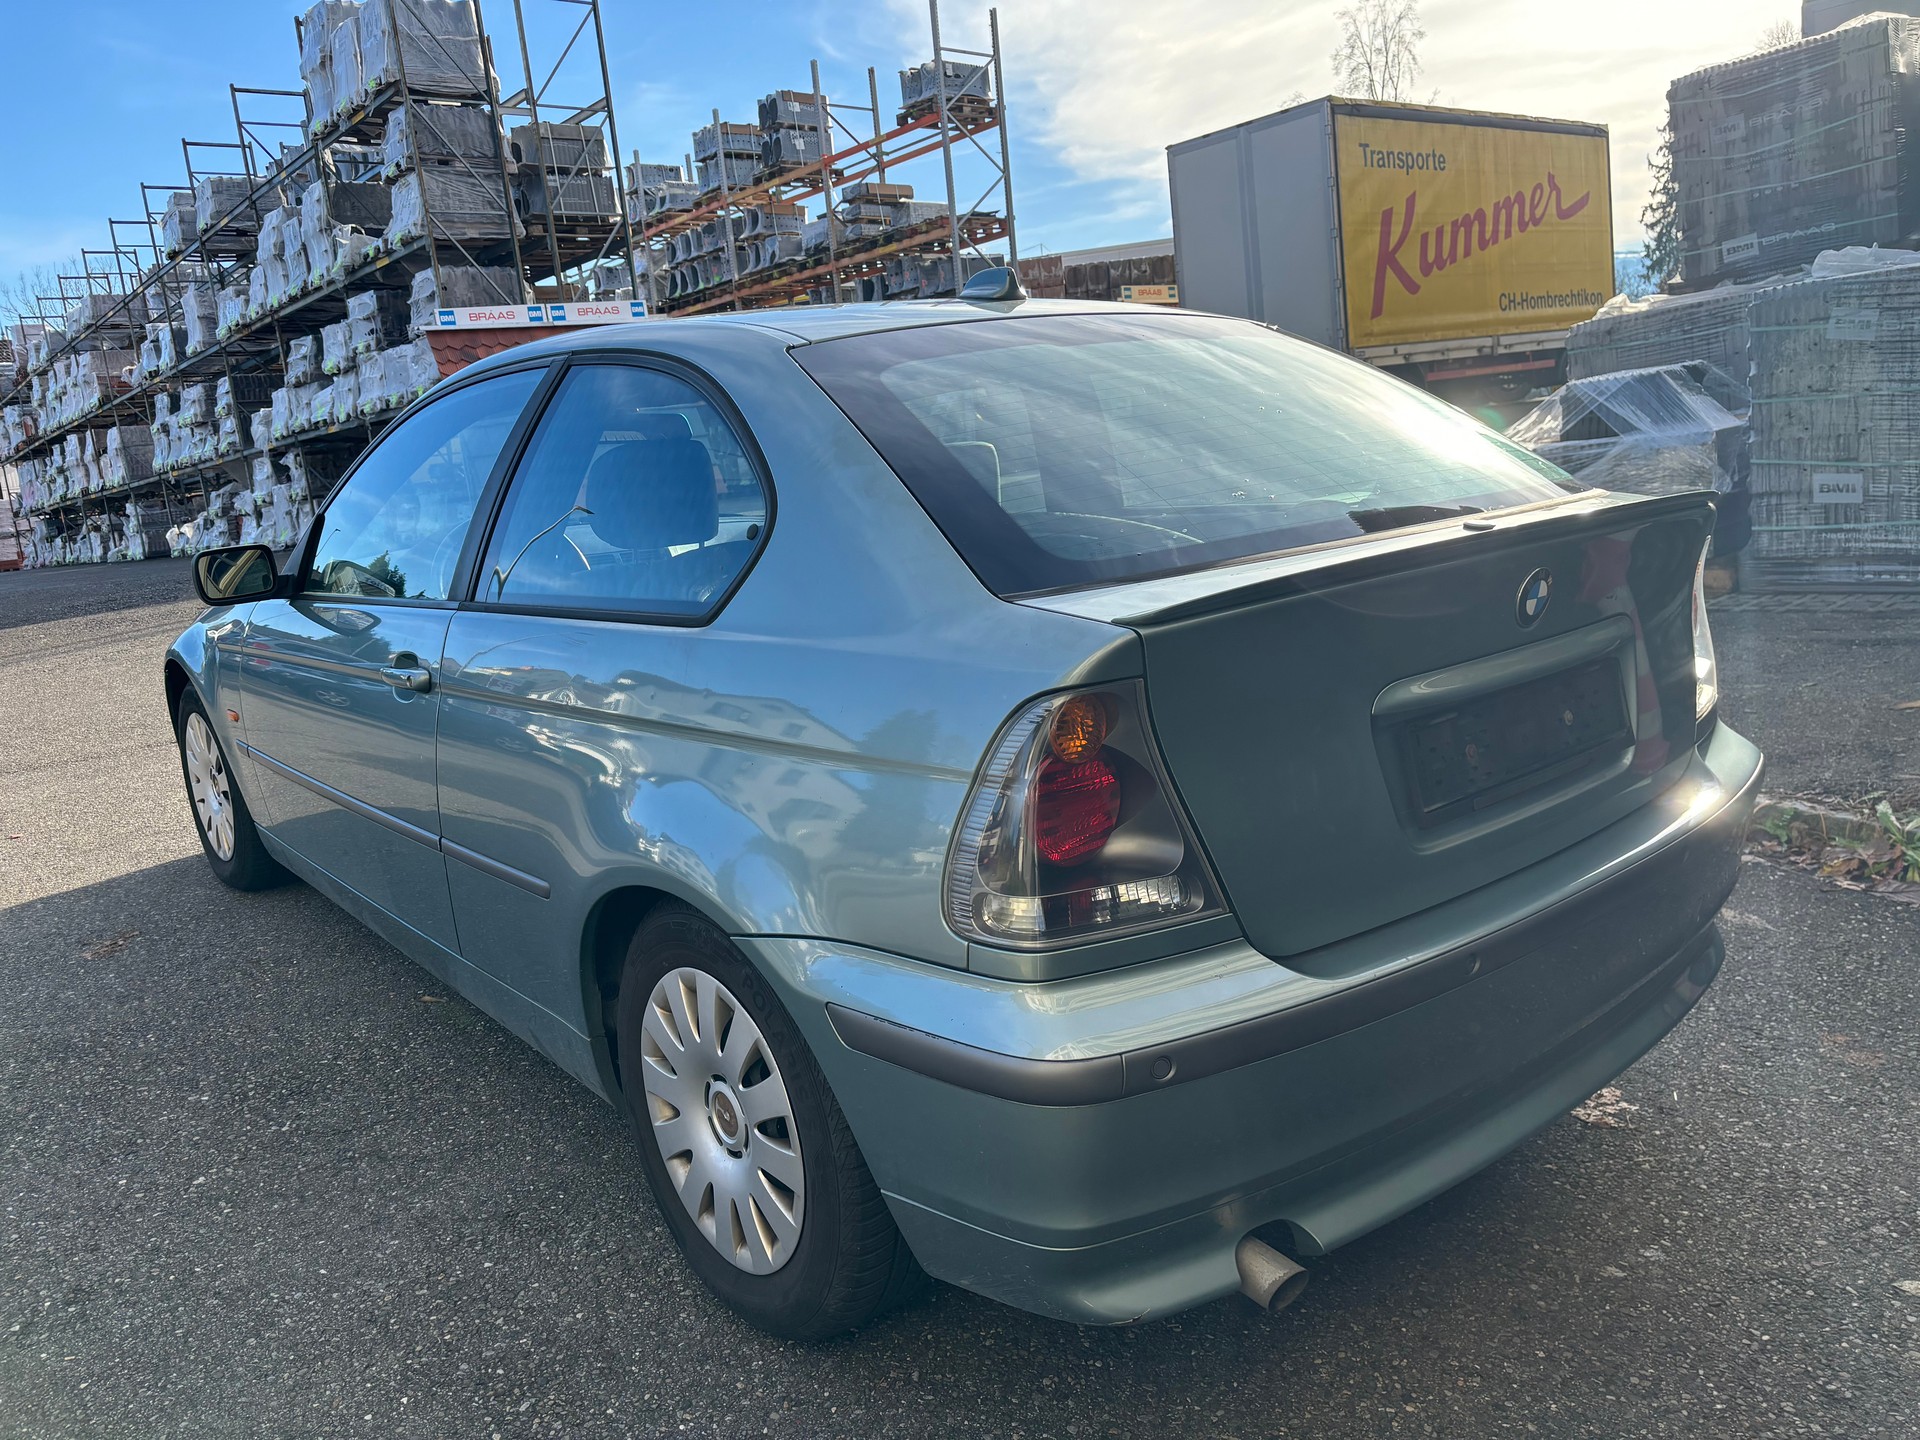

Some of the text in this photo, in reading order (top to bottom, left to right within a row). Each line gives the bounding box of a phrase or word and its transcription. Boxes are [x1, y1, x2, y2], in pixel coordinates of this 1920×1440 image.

[1358, 143, 1447, 175] Transporte
[1370, 171, 1591, 320] Kummer
[1762, 222, 1836, 246] BRAAS
[1498, 288, 1603, 312] CH-Hombrechtikon
[1819, 483, 1857, 494] BMI
